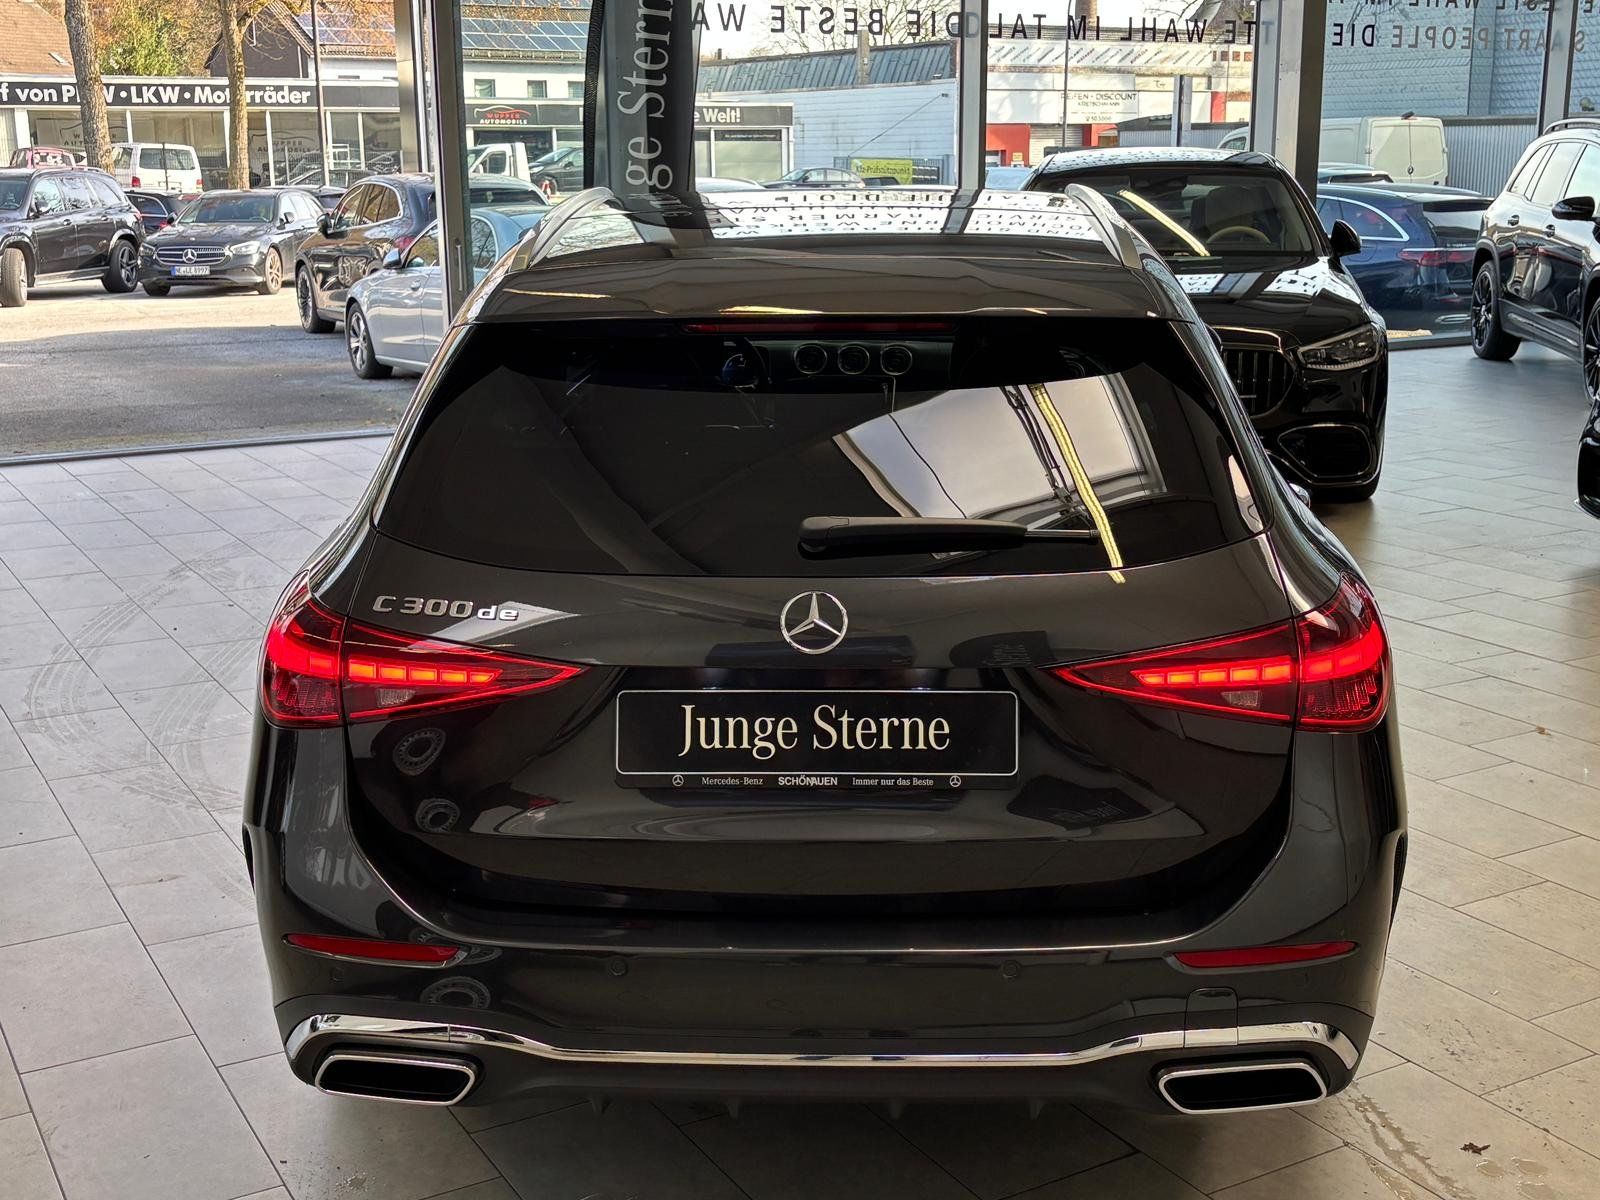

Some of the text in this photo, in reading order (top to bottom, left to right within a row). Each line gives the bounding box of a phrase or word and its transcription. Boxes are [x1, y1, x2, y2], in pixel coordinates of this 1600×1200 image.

[15, 88, 58, 102] von
[131, 86, 180, 104] LKW
[702, 107, 741, 123] Welt!
[372, 595, 519, 621] C 300 de
[677, 704, 950, 760] Junge Sterne
[701, 776, 764, 786] Mercedes-Benz
[852, 776, 879, 786] Immer
[896, 776, 911, 786] das
[912, 776, 934, 786] Beste
